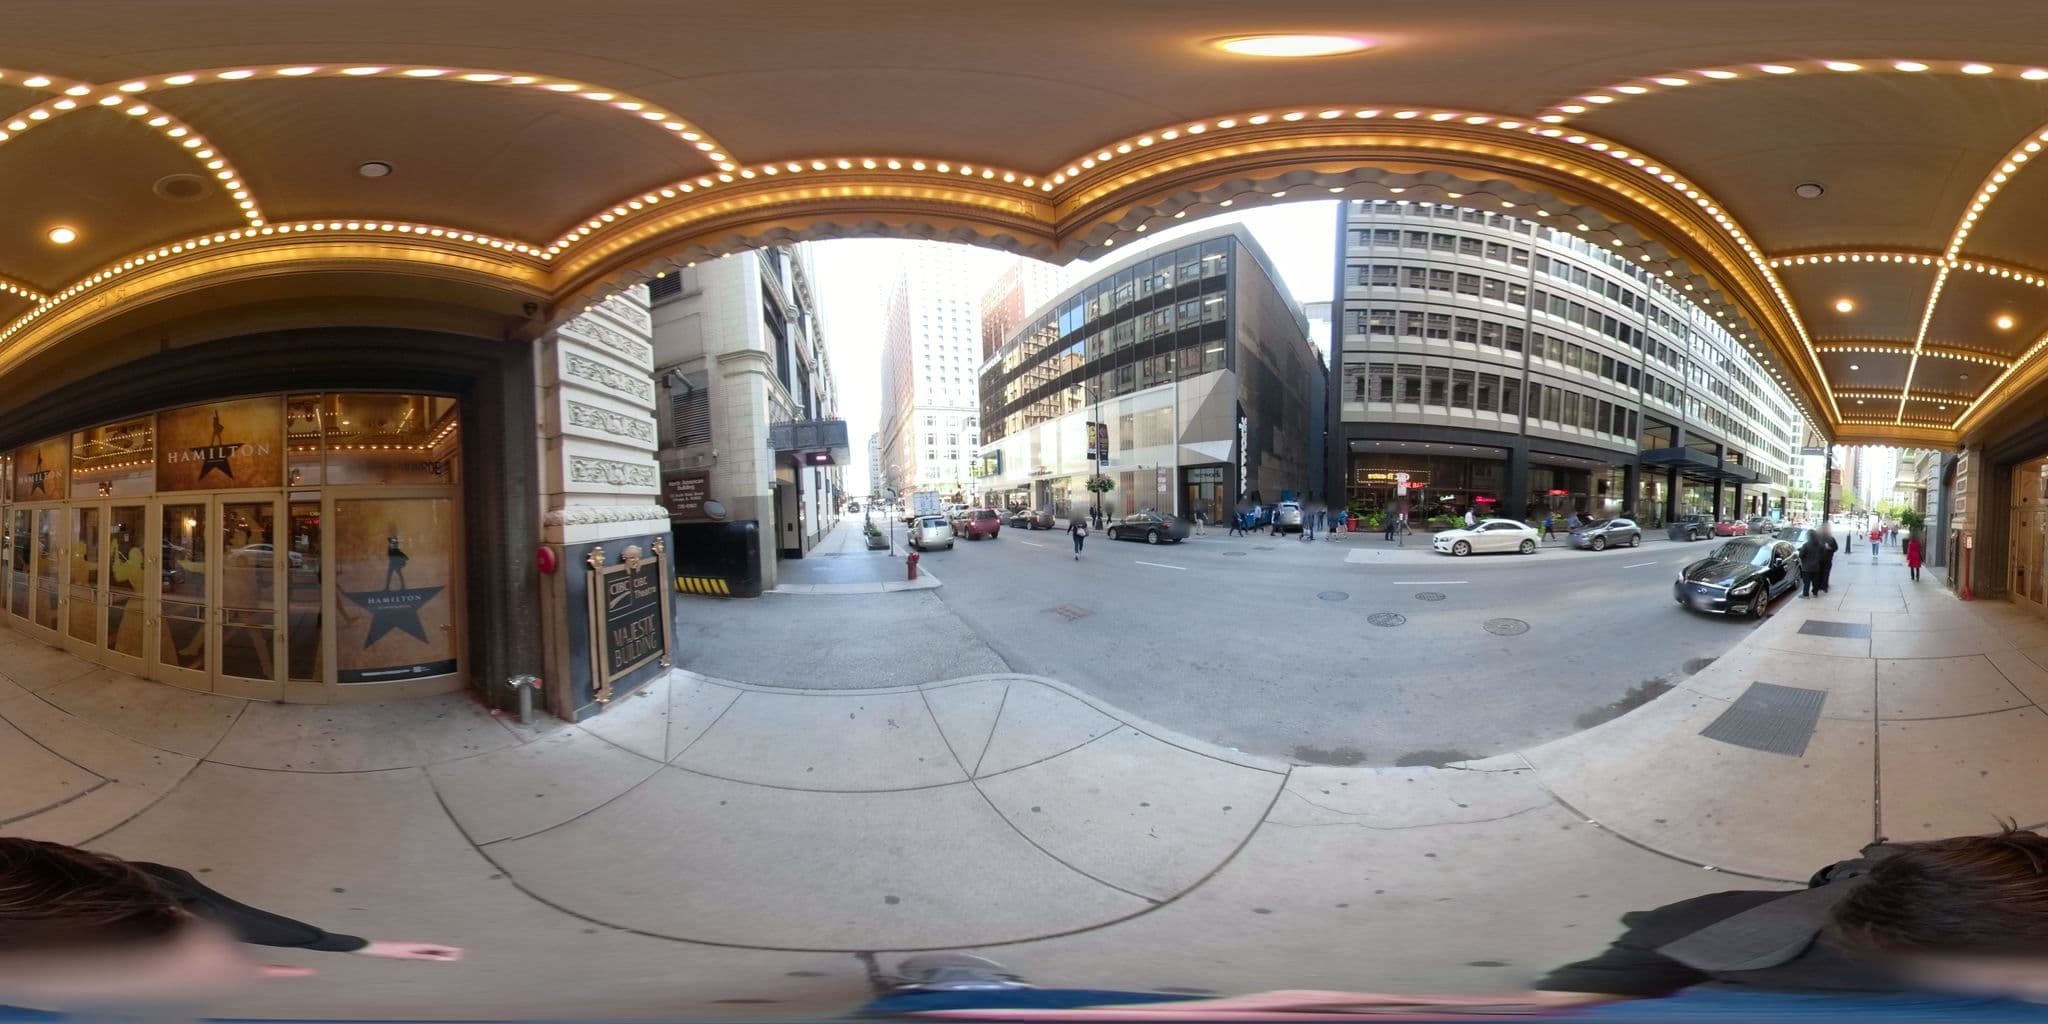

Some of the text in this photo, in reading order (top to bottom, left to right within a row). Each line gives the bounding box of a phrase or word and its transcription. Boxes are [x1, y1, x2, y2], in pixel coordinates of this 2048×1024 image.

[168, 444, 270, 463] HAMILTON
[1238, 416, 1247, 494] wework
[368, 594, 422, 604] HAMILTON
[610, 581, 630, 595] CIBC
[614, 614, 656, 647] MAJESTIC
[615, 632, 657, 667] BUILDING
